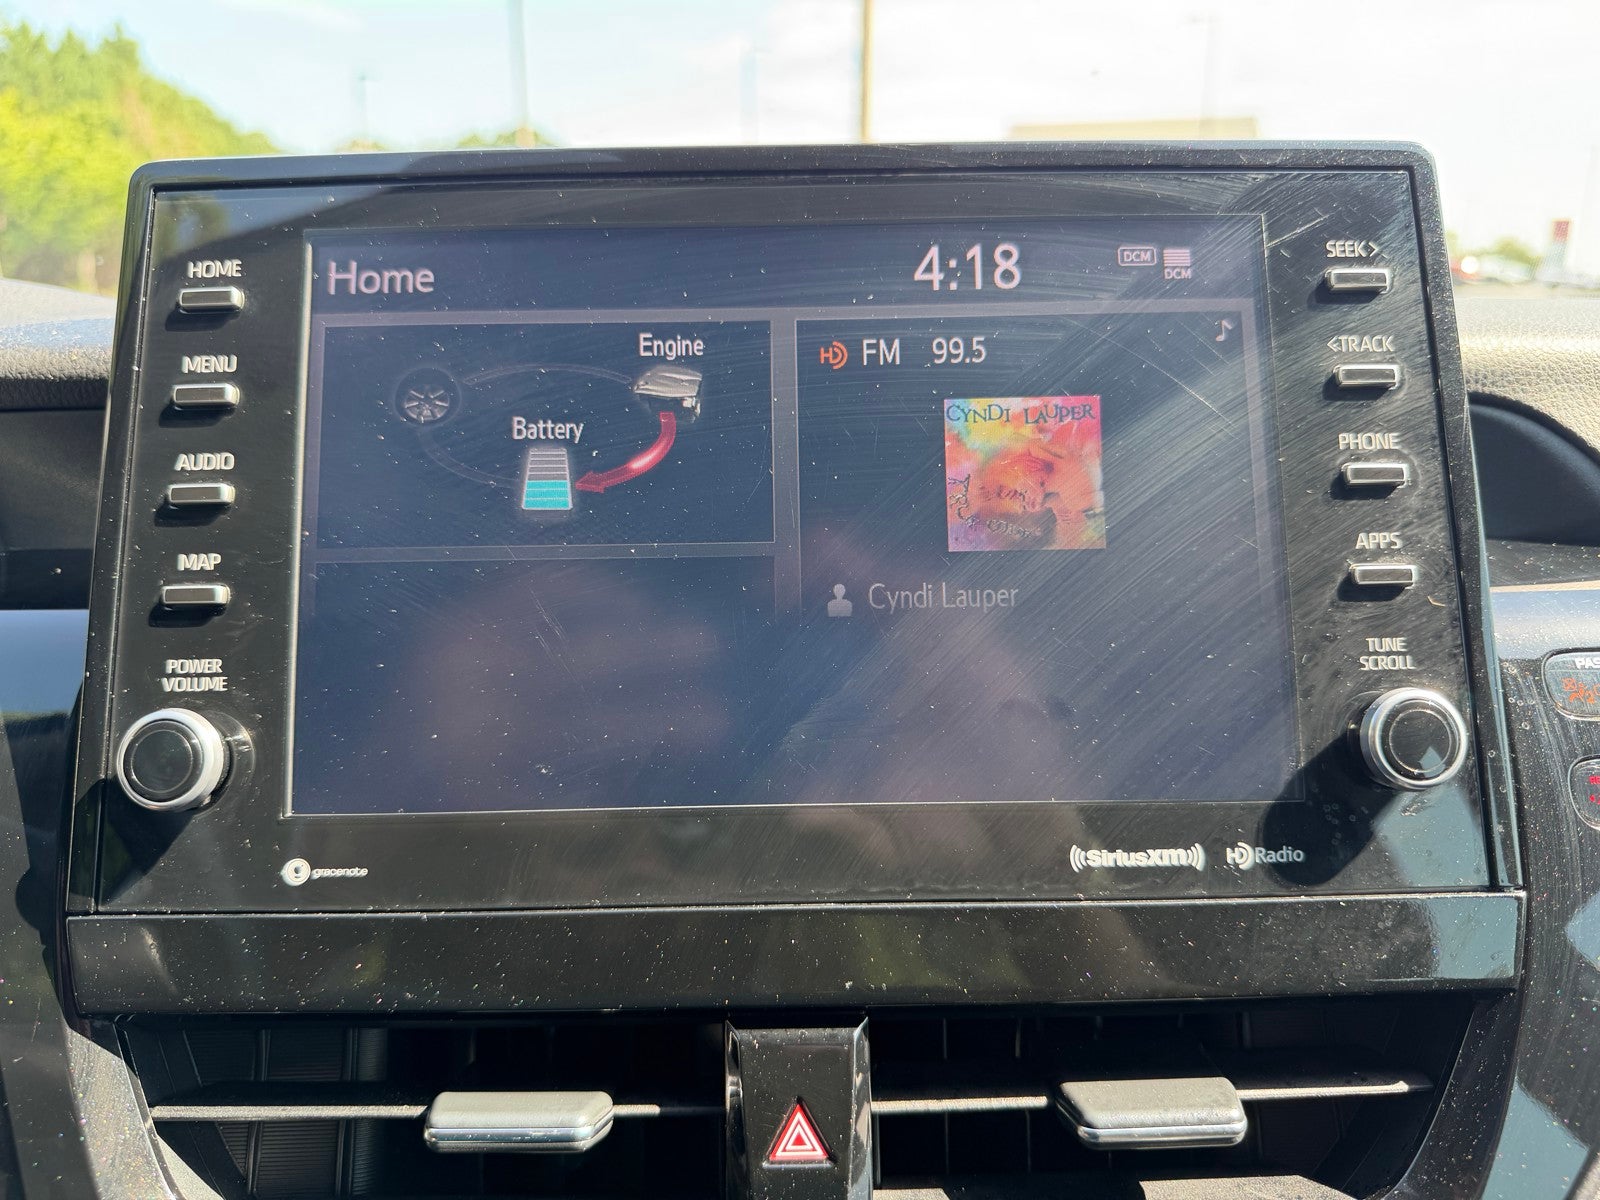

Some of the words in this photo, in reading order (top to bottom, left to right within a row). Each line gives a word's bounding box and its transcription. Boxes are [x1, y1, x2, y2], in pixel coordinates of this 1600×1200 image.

[1123, 250, 1151, 262] DCM
[187, 259, 242, 279] HOME
[914, 244, 1021, 291] 4:18
[1164, 268, 1192, 280] DCM
[327, 261, 436, 295] Home
[638, 332, 705, 360] Engine
[861, 338, 901, 366] FM
[931, 336, 987, 365] 99.5
[181, 354, 238, 374] MENU
[1024, 403, 1096, 426] LAUPER
[511, 415, 584, 443] Battery
[1338, 432, 1399, 451] PHONE
[174, 452, 235, 471] AUDIO
[1355, 532, 1402, 550] APPS
[176, 553, 221, 572] MAP
[868, 582, 933, 615] Cyndi
[941, 581, 1019, 613] Lauper
[1366, 636, 1408, 653] TUNE
[165, 658, 222, 674] POWER
[1359, 655, 1414, 671] SCROLL
[161, 676, 228, 692] VOLUME
[1254, 845, 1304, 864] Radio
